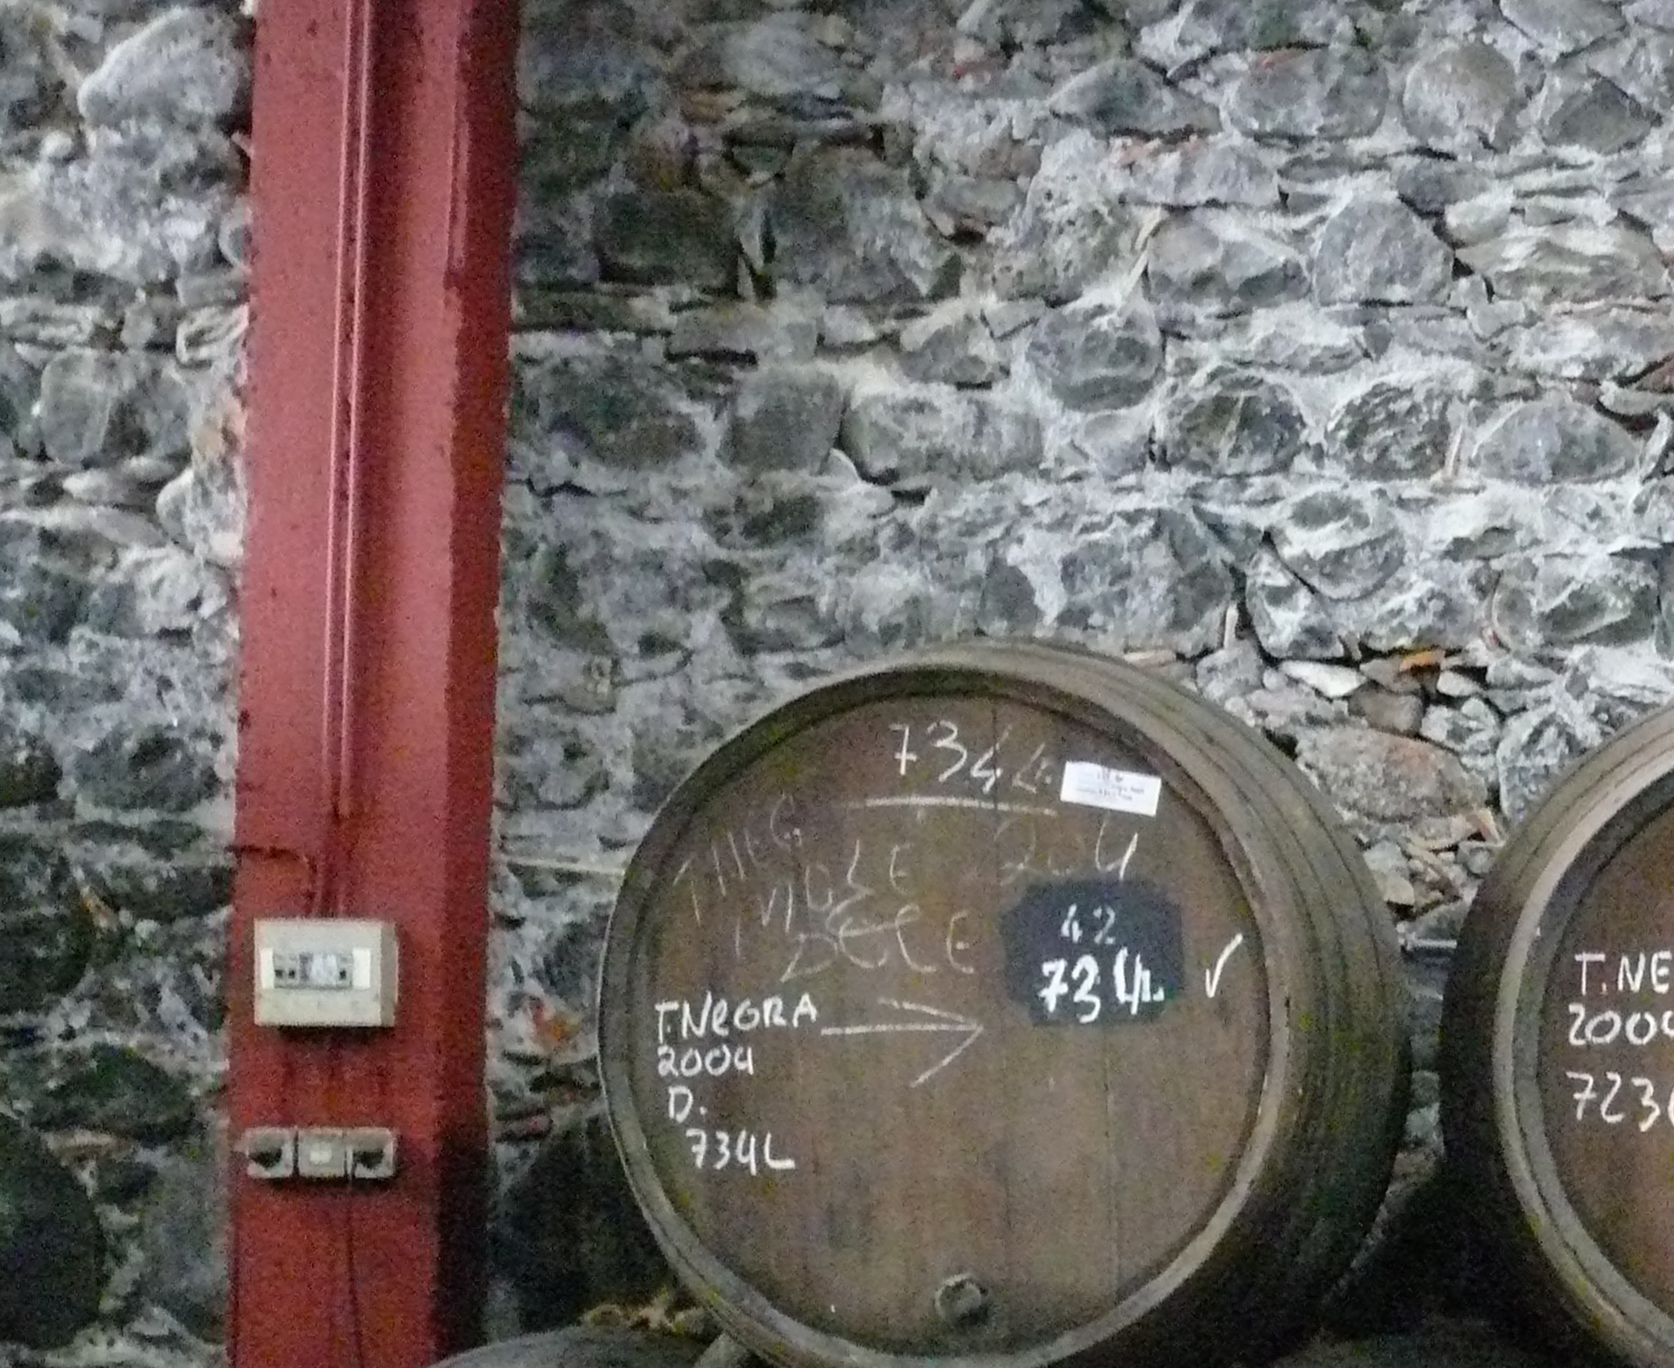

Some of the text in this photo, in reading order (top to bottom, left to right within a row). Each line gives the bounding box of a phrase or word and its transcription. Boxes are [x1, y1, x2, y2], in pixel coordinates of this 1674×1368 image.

[1060, 903, 1116, 944] 42
[657, 1043, 755, 1078] 2004
[685, 1127, 796, 1177] 734L
